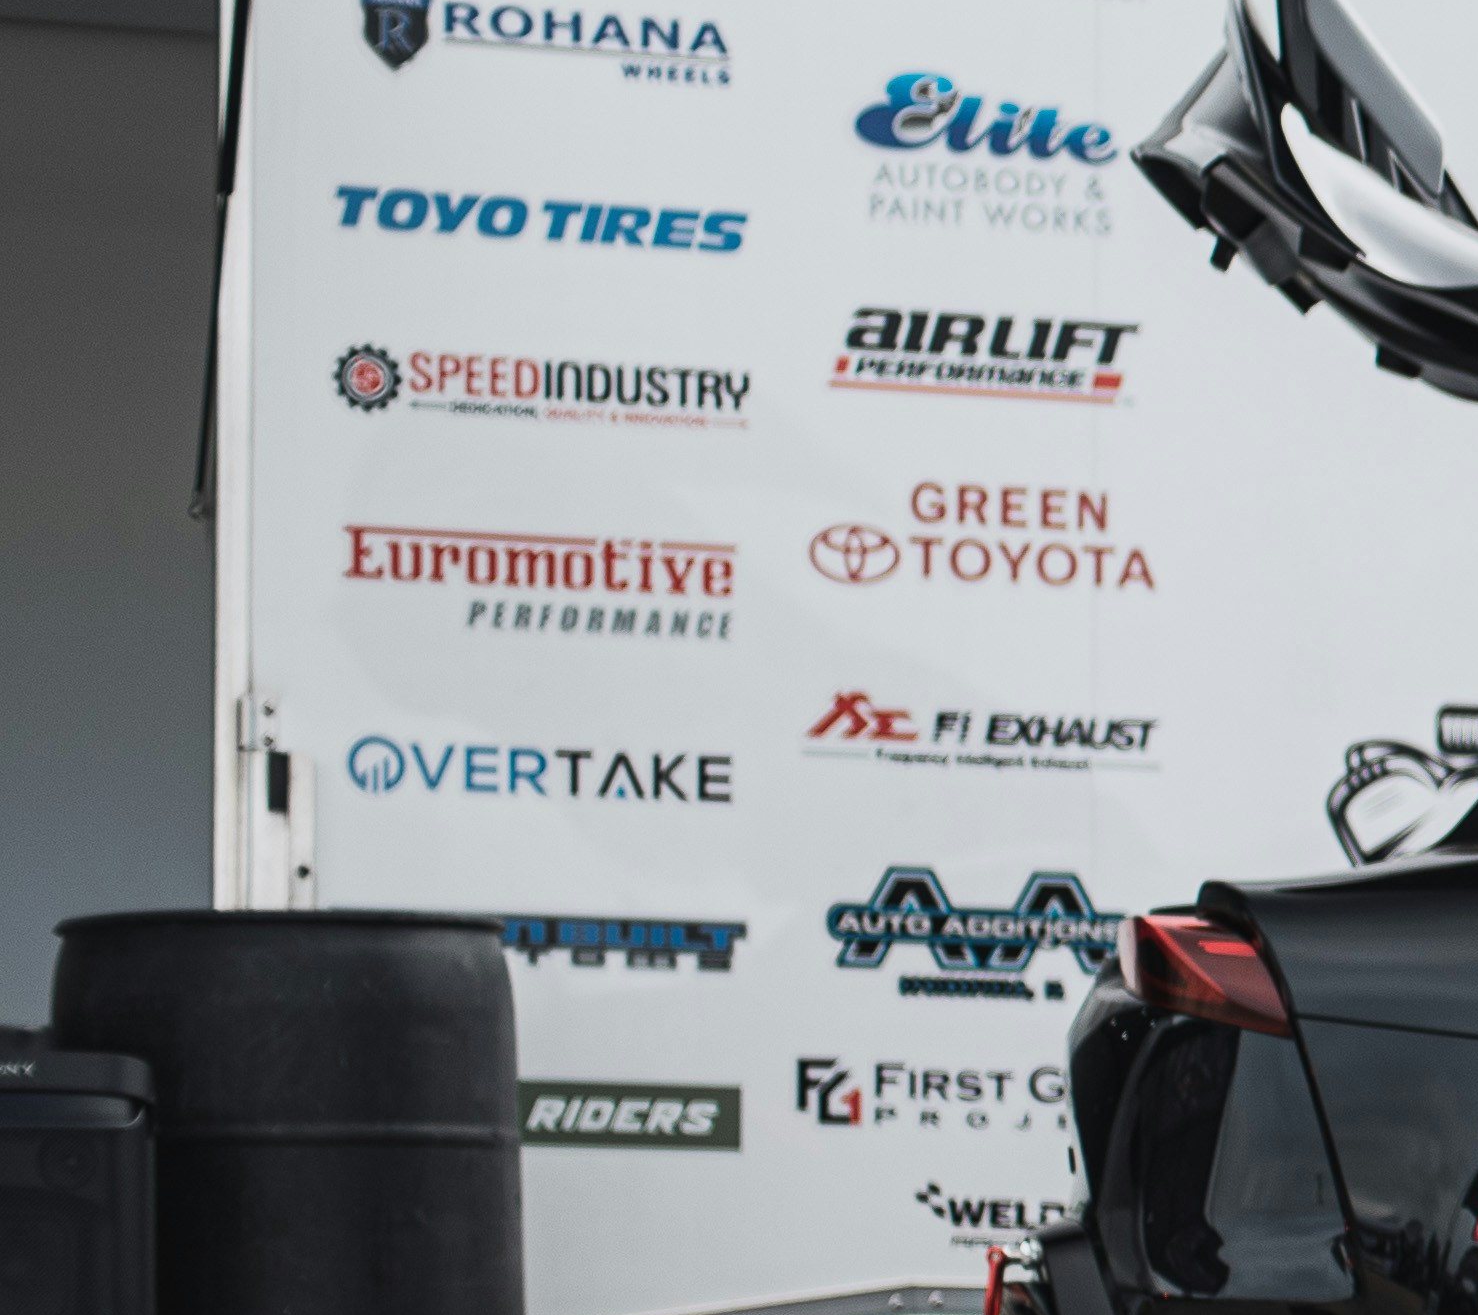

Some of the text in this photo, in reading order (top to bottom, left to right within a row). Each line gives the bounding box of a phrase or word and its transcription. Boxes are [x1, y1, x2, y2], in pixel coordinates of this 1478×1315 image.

[443, 1, 729, 55] ROHANA
[621, 62, 732, 86] WHEELS
[854, 72, 1118, 165] Elite
[872, 163, 1067, 197] AUTOBODY
[336, 185, 749, 253] TOYO TIRES
[868, 192, 1113, 237] PAINT WORKS
[911, 482, 1108, 532] GREEN
[342, 525, 735, 597] Euromotive
[909, 537, 1156, 590] TOYOTA
[466, 599, 733, 640] PERFORMANCE
[985, 713, 1159, 751] EXHAUST
[347, 734, 734, 804] OVERTAKE
[835, 911, 932, 935] AUTO
[874, 1061, 1015, 1101] FIRST
[524, 1094, 719, 1136] RIDERS
